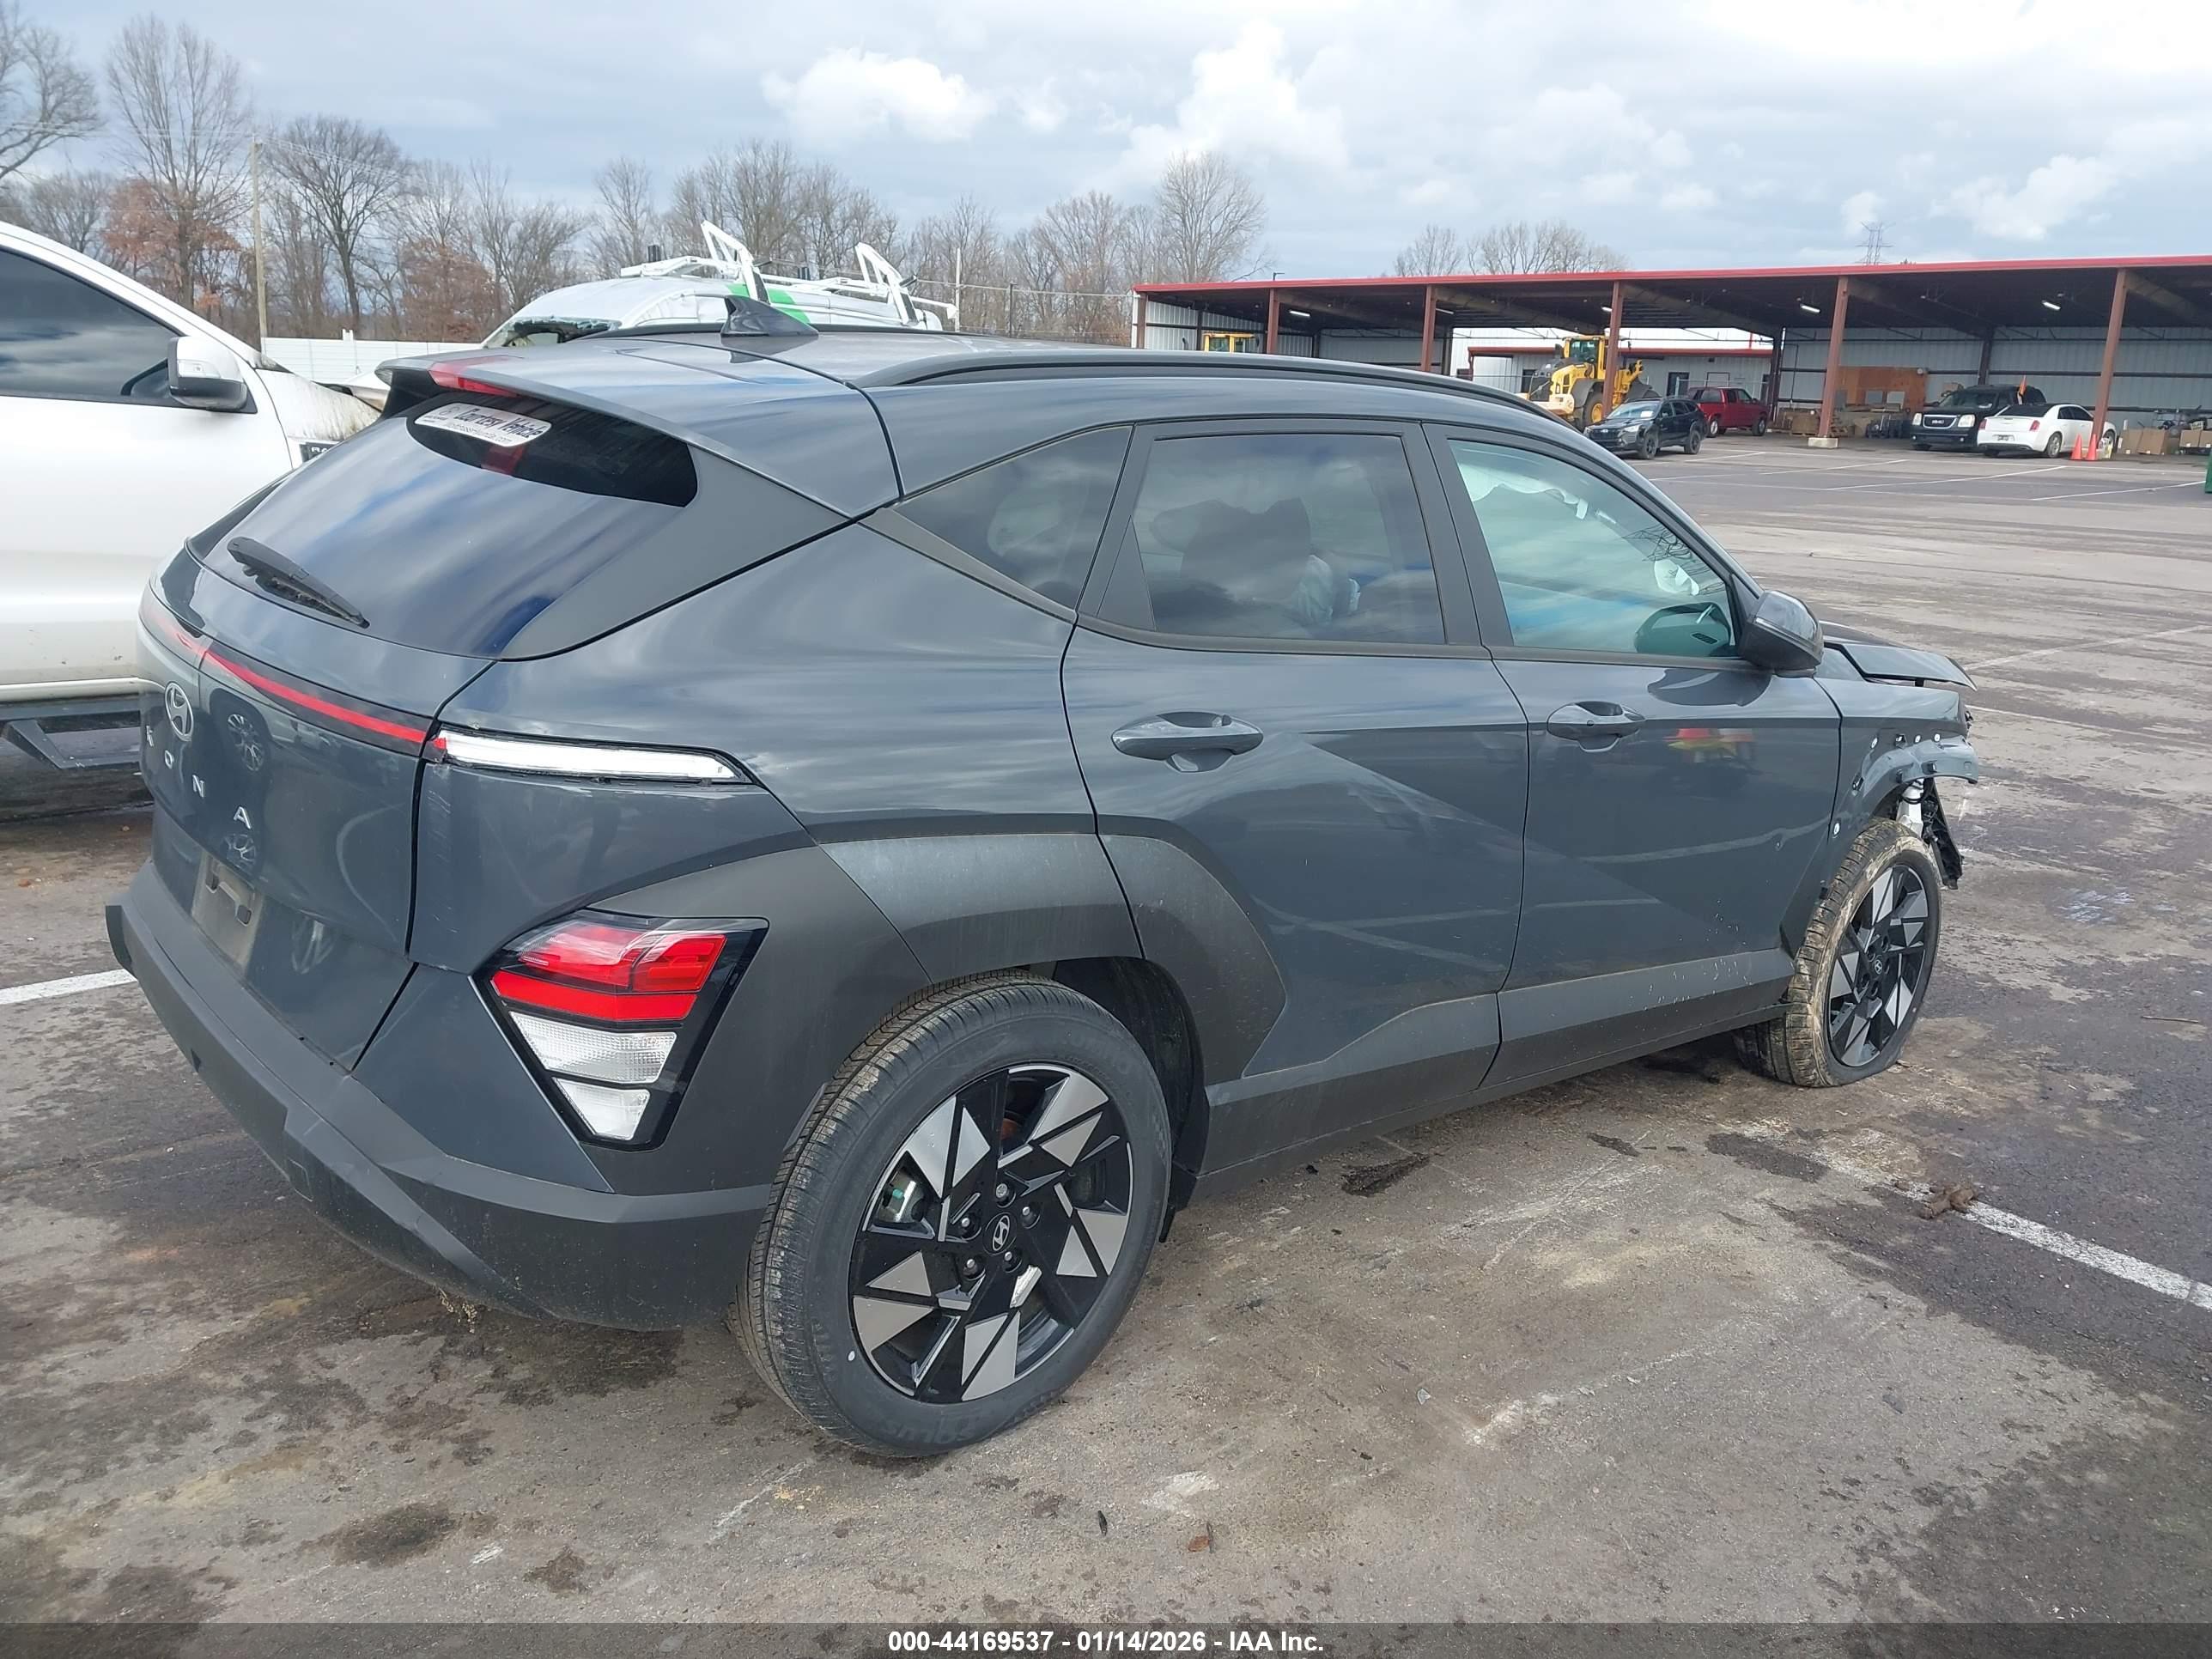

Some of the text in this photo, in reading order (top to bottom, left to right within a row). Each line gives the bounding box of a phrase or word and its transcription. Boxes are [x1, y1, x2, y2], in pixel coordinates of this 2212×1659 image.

[454, 408, 506, 428] Courtesy
[501, 417, 544, 438] Vehicle
[145, 725, 252, 830] KONA
